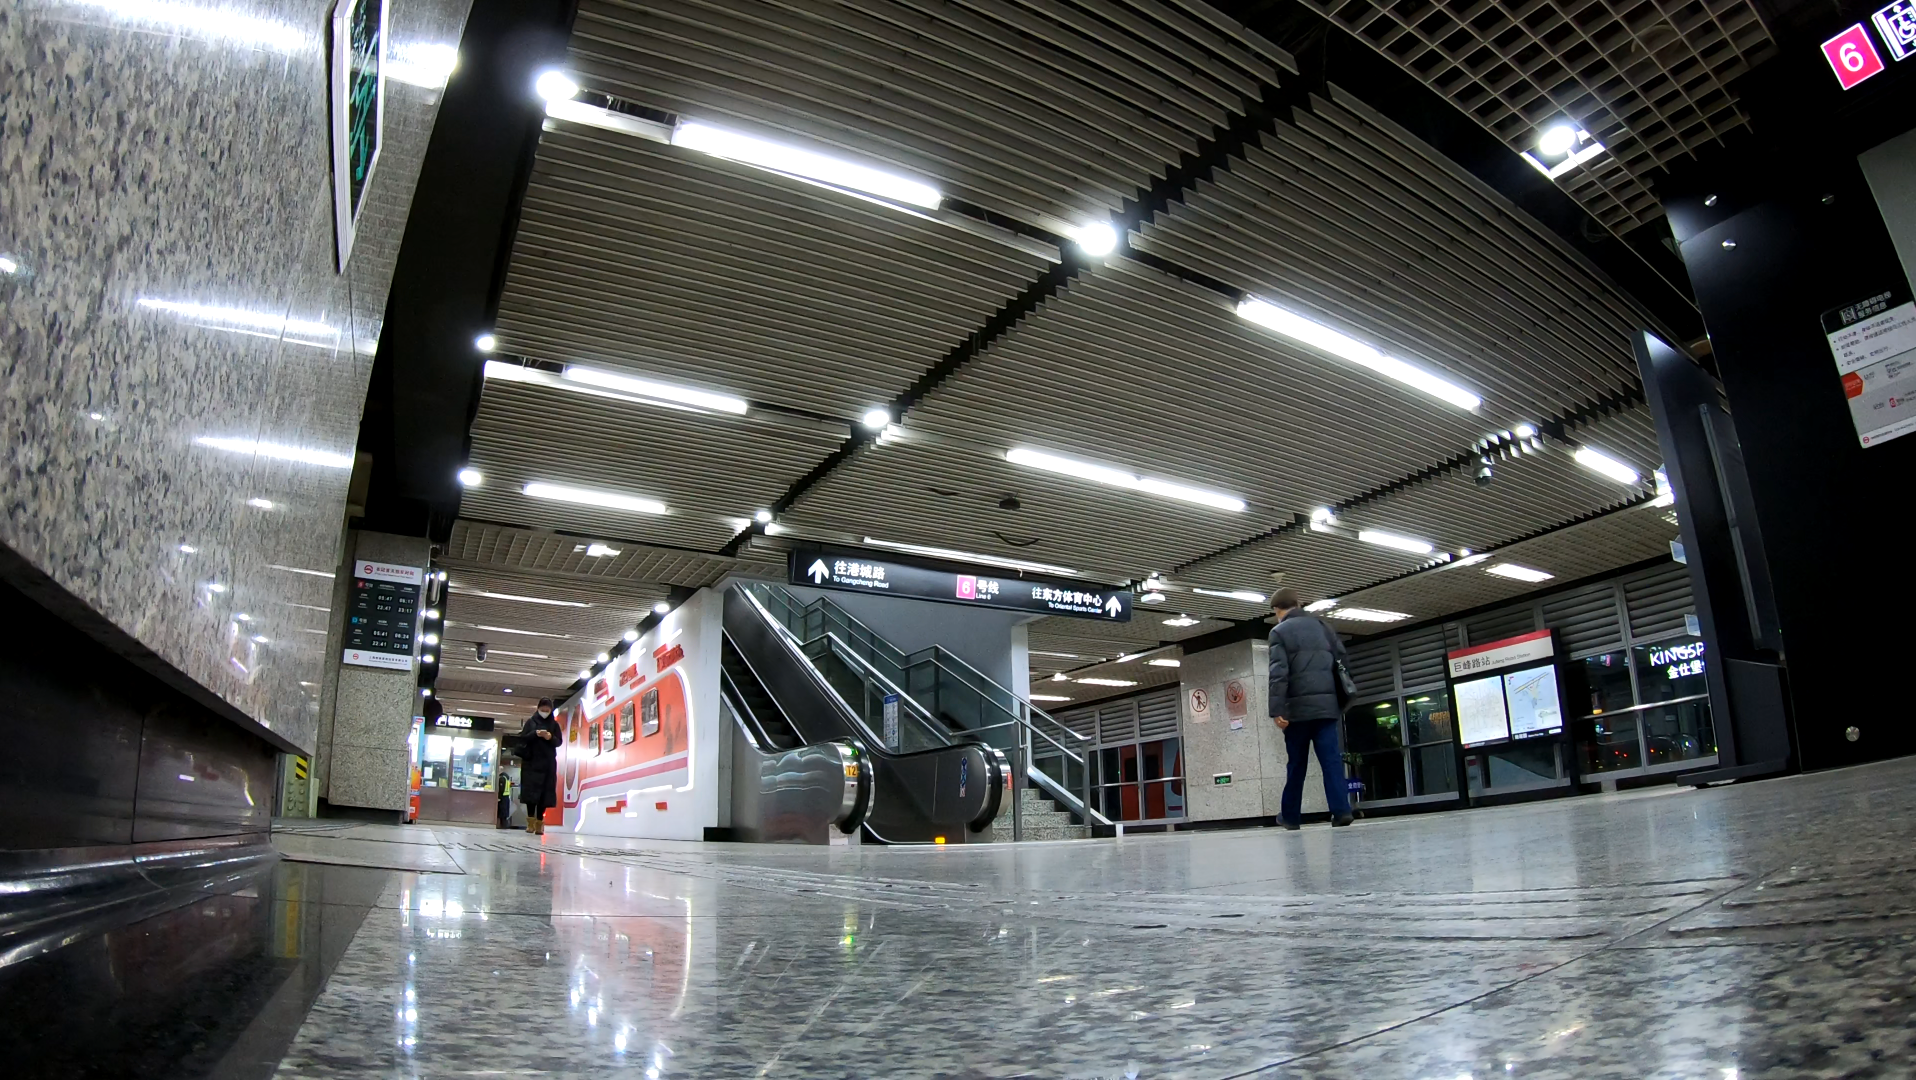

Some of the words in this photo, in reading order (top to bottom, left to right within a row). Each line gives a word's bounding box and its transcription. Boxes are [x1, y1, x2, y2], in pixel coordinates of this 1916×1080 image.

[1840, 42, 1864, 72] 6
[834, 560, 885, 580] 往港城路
[841, 576, 873, 587] Gangcheng
[874, 580, 889, 588] Road
[977, 580, 999, 594] 号线
[1031, 586, 1103, 607] 往东方体育中心
[1073, 604, 1088, 612] Sports
[1088, 606, 1103, 614] Center
[1454, 655, 1490, 673] 巨峰路站
[1667, 659, 1704, 680] 金仕堡
[847, 766, 856, 776] T2
